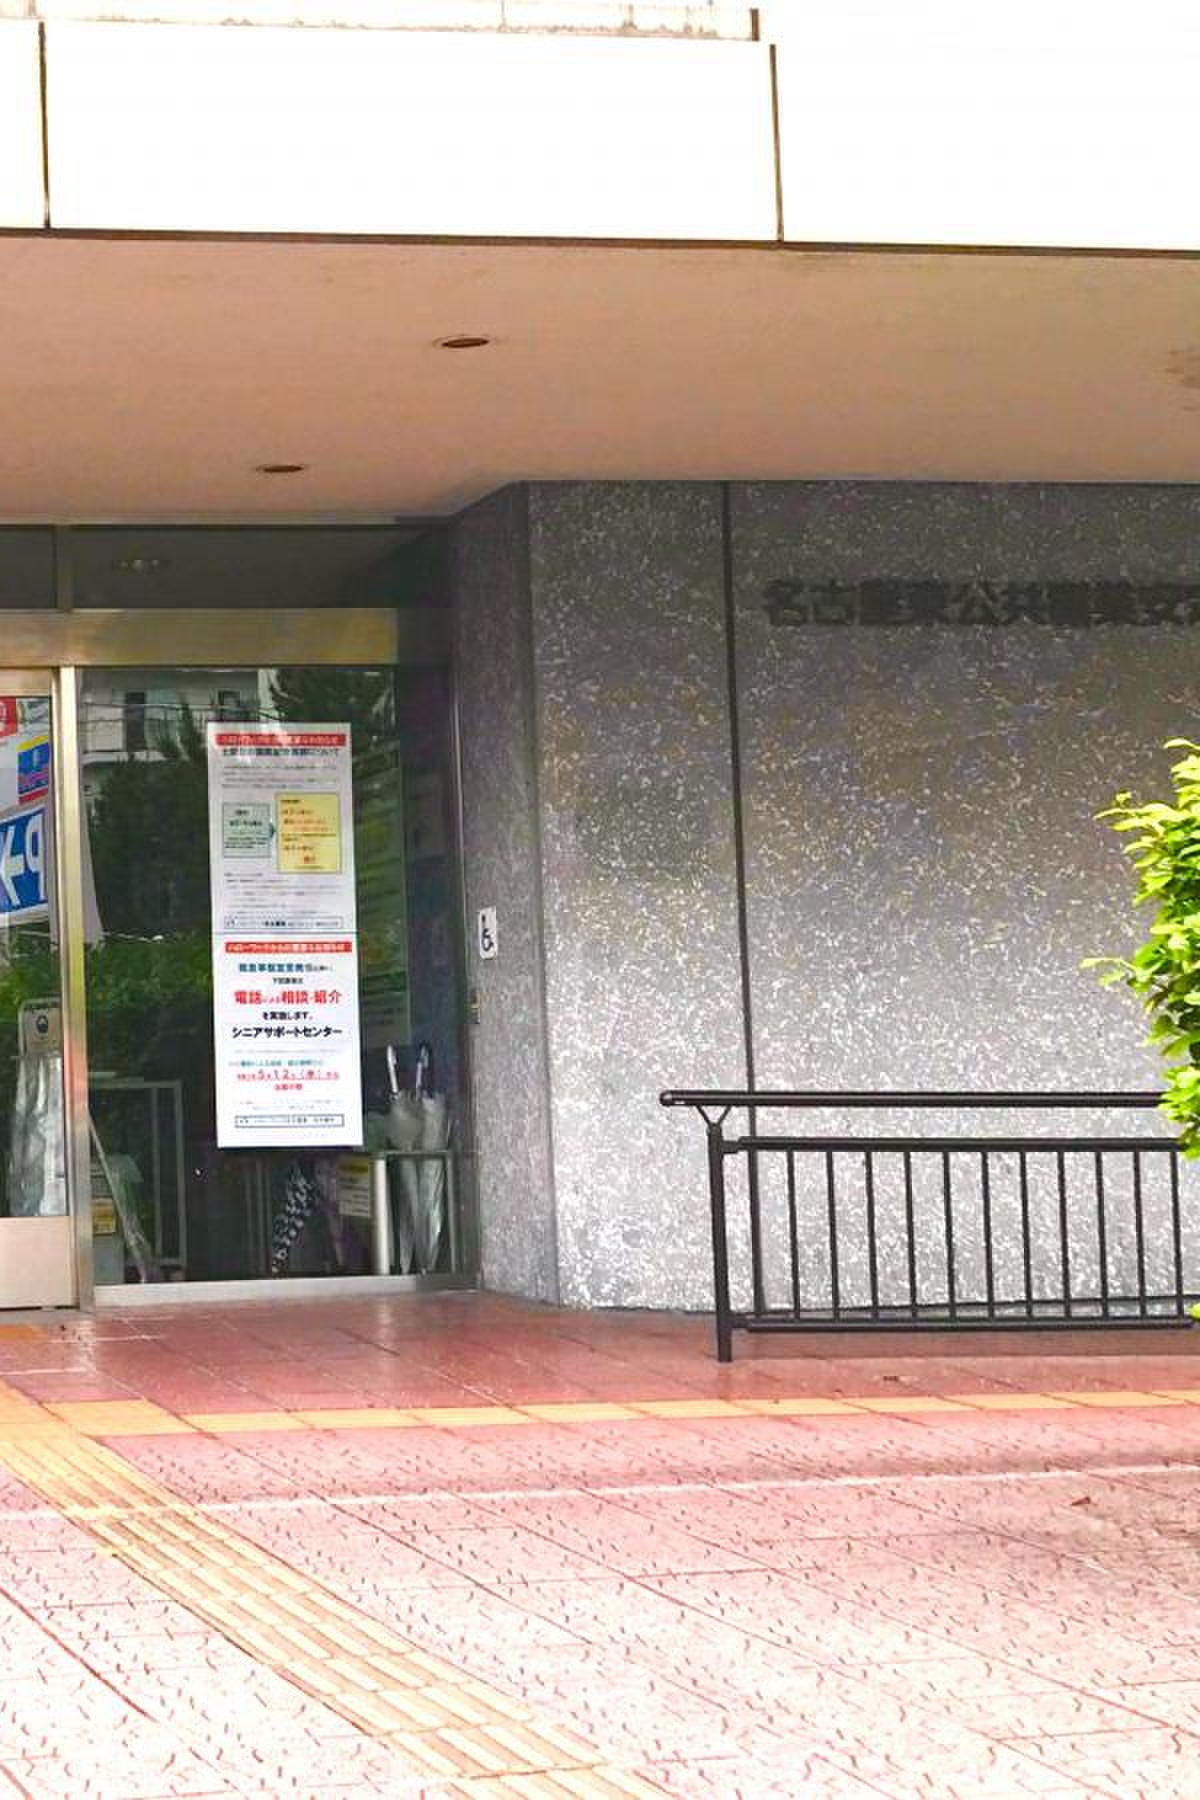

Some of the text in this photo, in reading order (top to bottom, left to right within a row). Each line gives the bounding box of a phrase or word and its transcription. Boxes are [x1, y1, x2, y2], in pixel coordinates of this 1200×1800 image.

[231, 1026, 343, 1039] シニアサポートセンター
